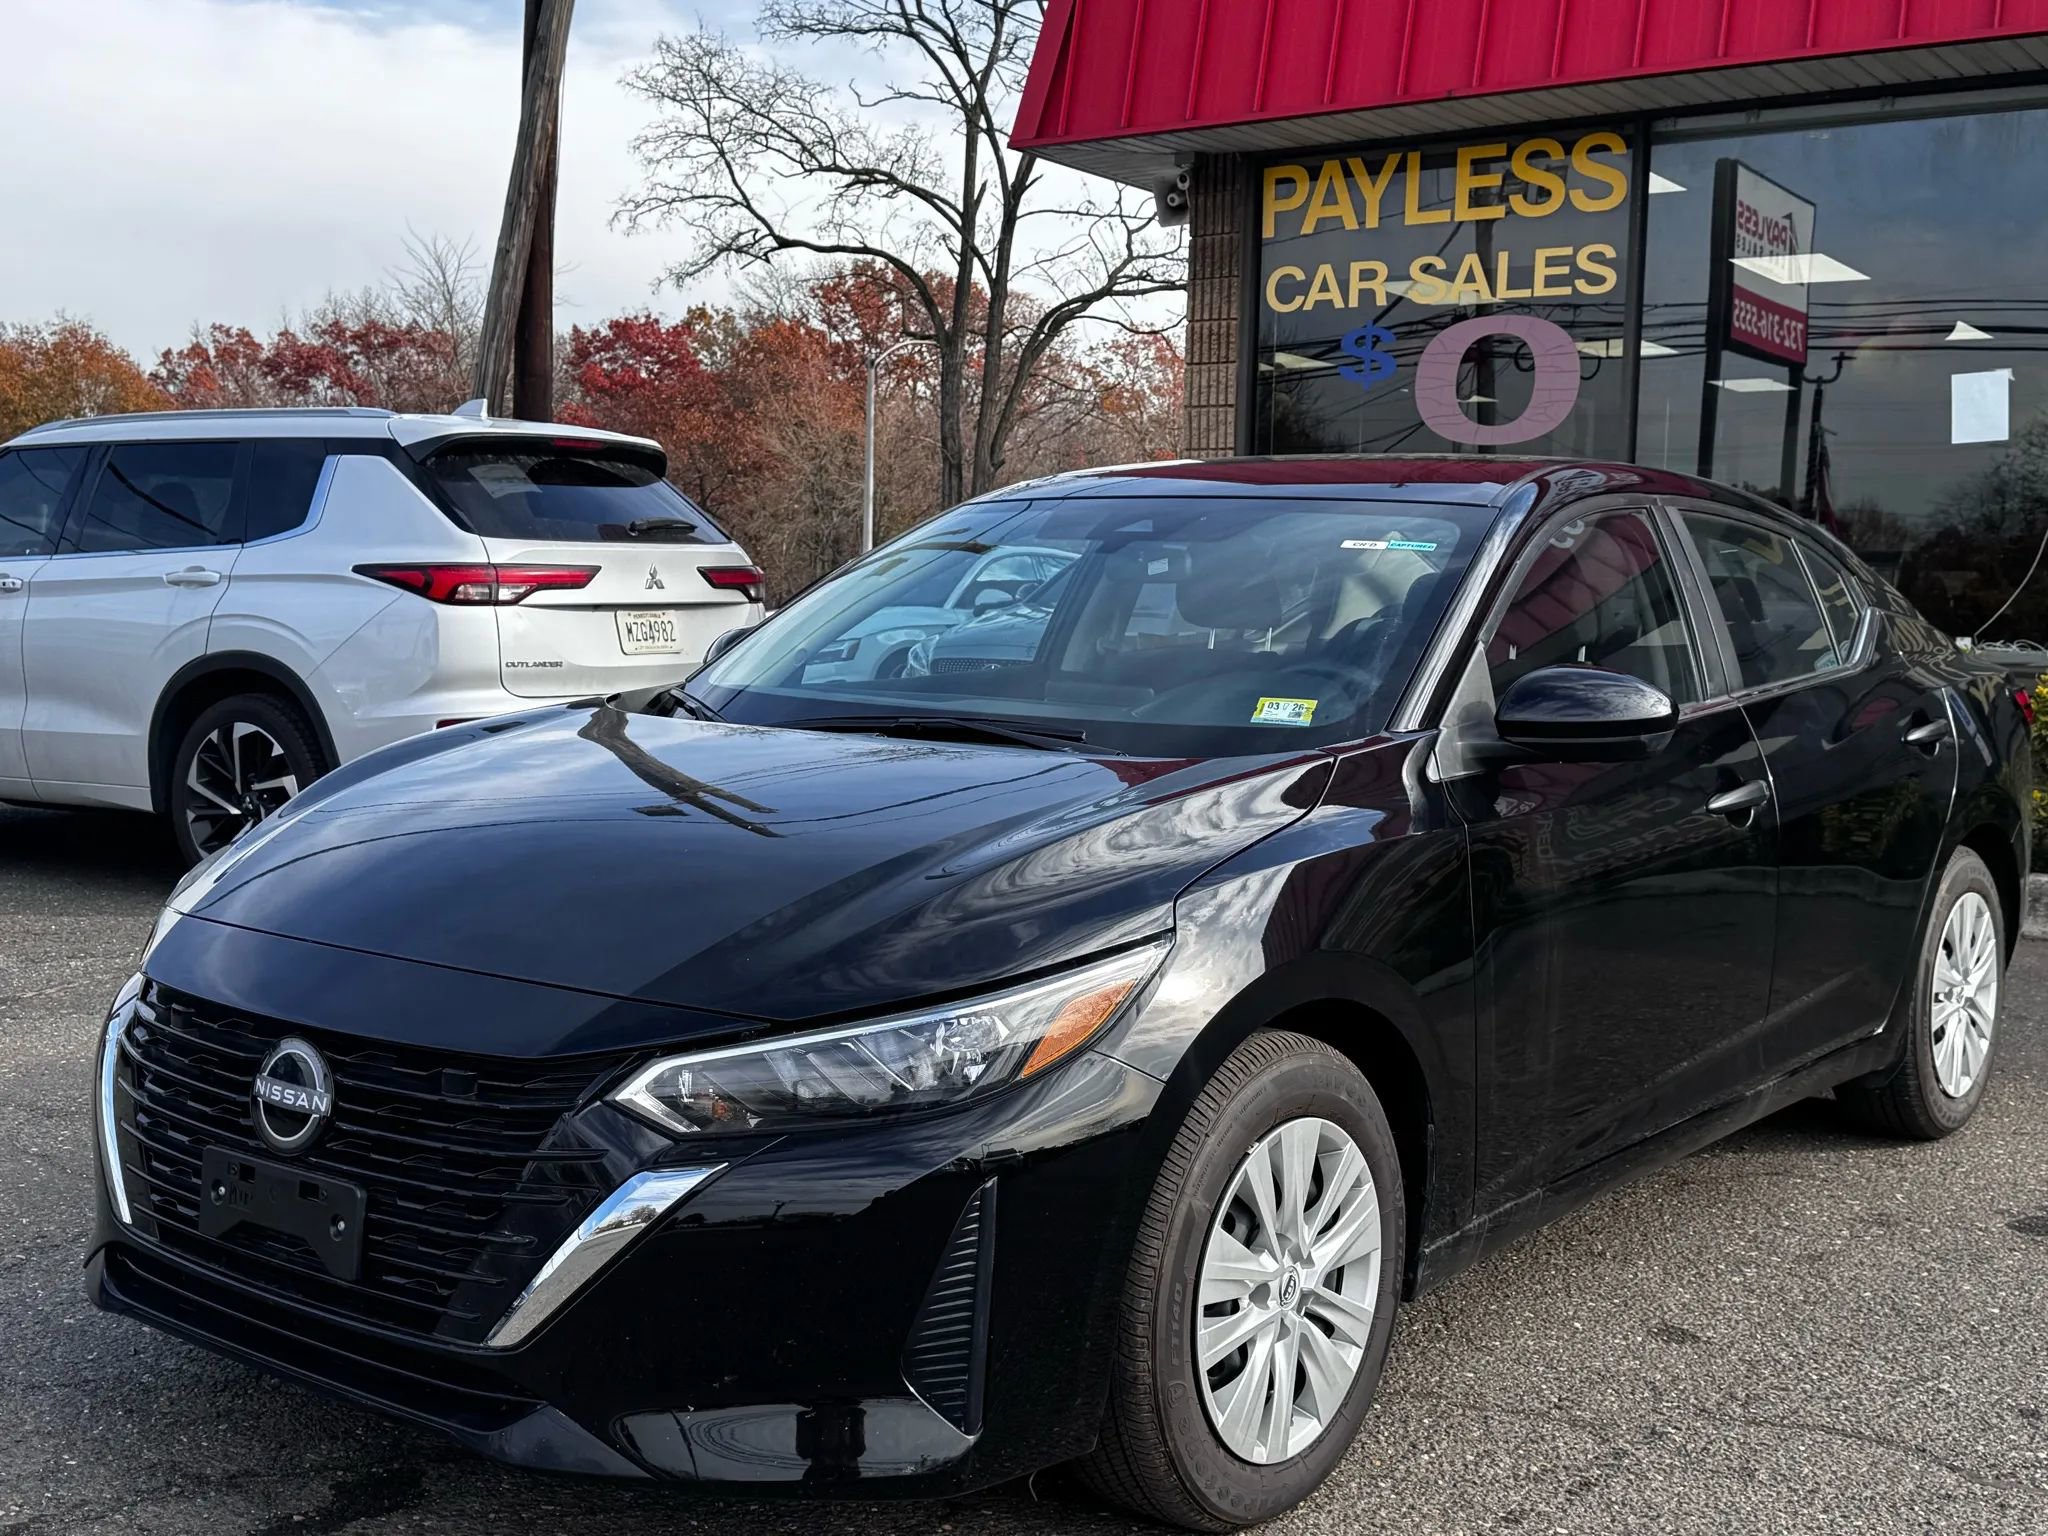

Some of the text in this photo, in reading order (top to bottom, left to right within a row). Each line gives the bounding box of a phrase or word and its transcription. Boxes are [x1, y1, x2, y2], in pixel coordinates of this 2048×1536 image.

[1262, 132, 1628, 239] PAYLESS
[1266, 243, 1617, 313] CAR SALES
[625, 620, 676, 643] MZG4982
[1267, 702, 1280, 710] 03
[255, 1078, 327, 1112] NISSAN
